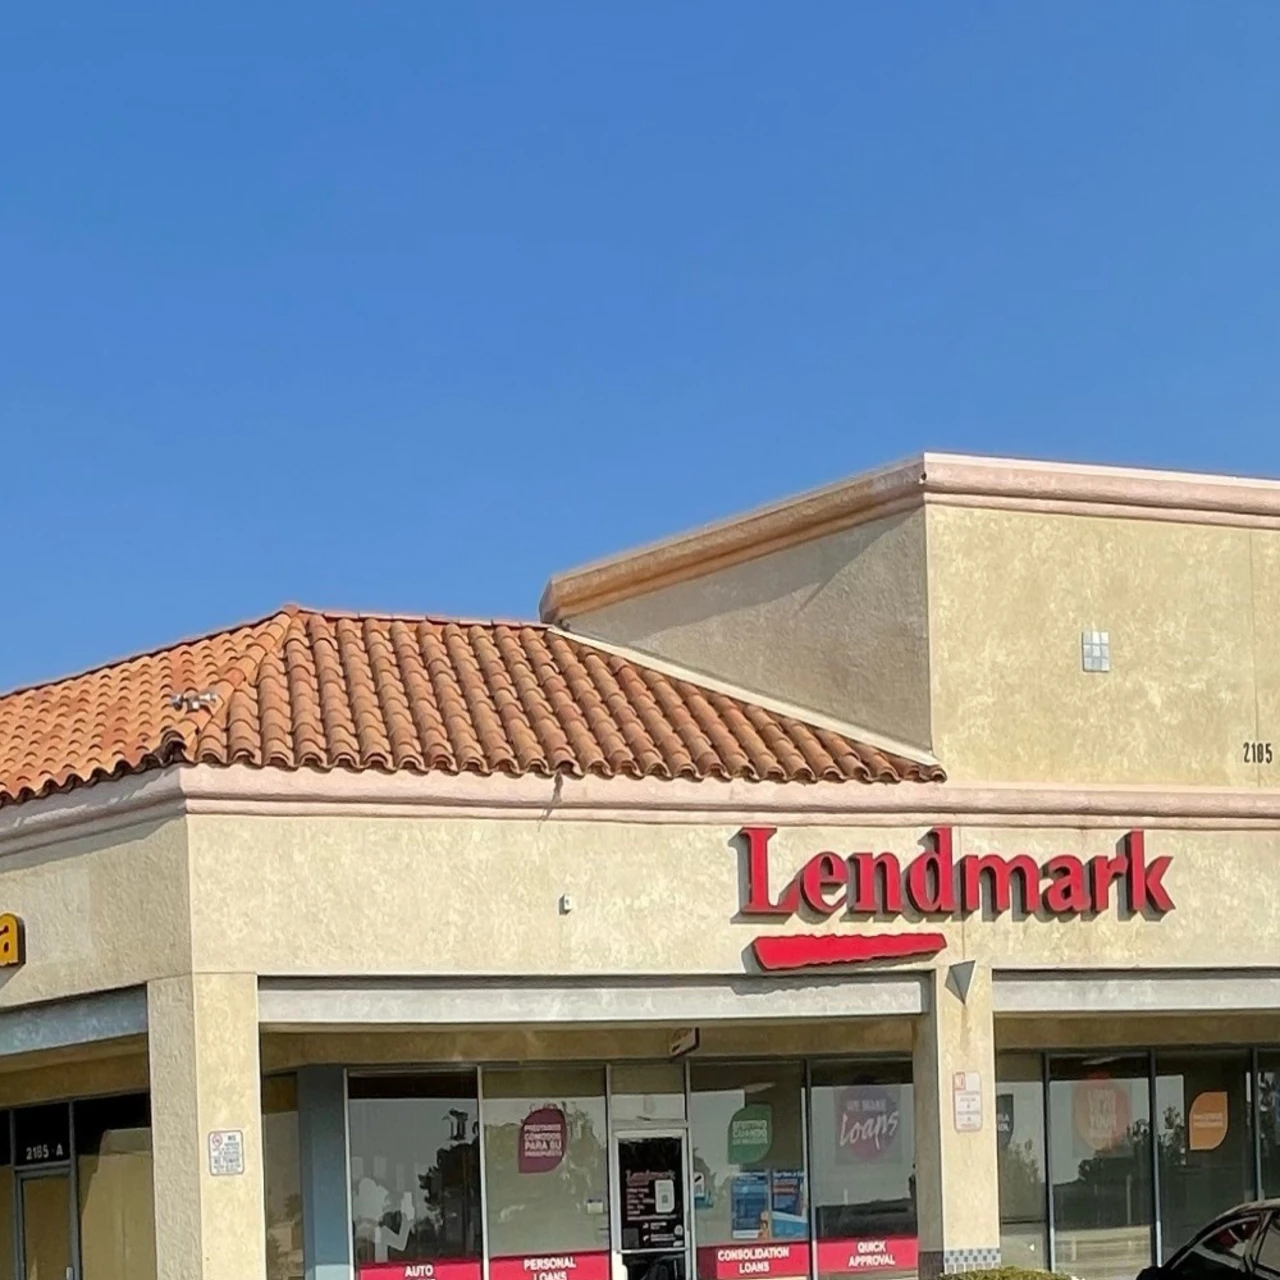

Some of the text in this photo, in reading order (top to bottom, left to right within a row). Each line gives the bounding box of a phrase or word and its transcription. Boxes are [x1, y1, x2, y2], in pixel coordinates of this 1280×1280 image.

[739, 826, 1176, 914] Lendmark
[717, 1246, 790, 1262] CONSOLIDATION
[857, 1240, 887, 1253] QUICK
[523, 1255, 577, 1271] PERSONAL
[738, 1260, 770, 1275] LOANS
[848, 1253, 896, 1268] APPROVAL
[404, 1264, 434, 1278] AUTO
